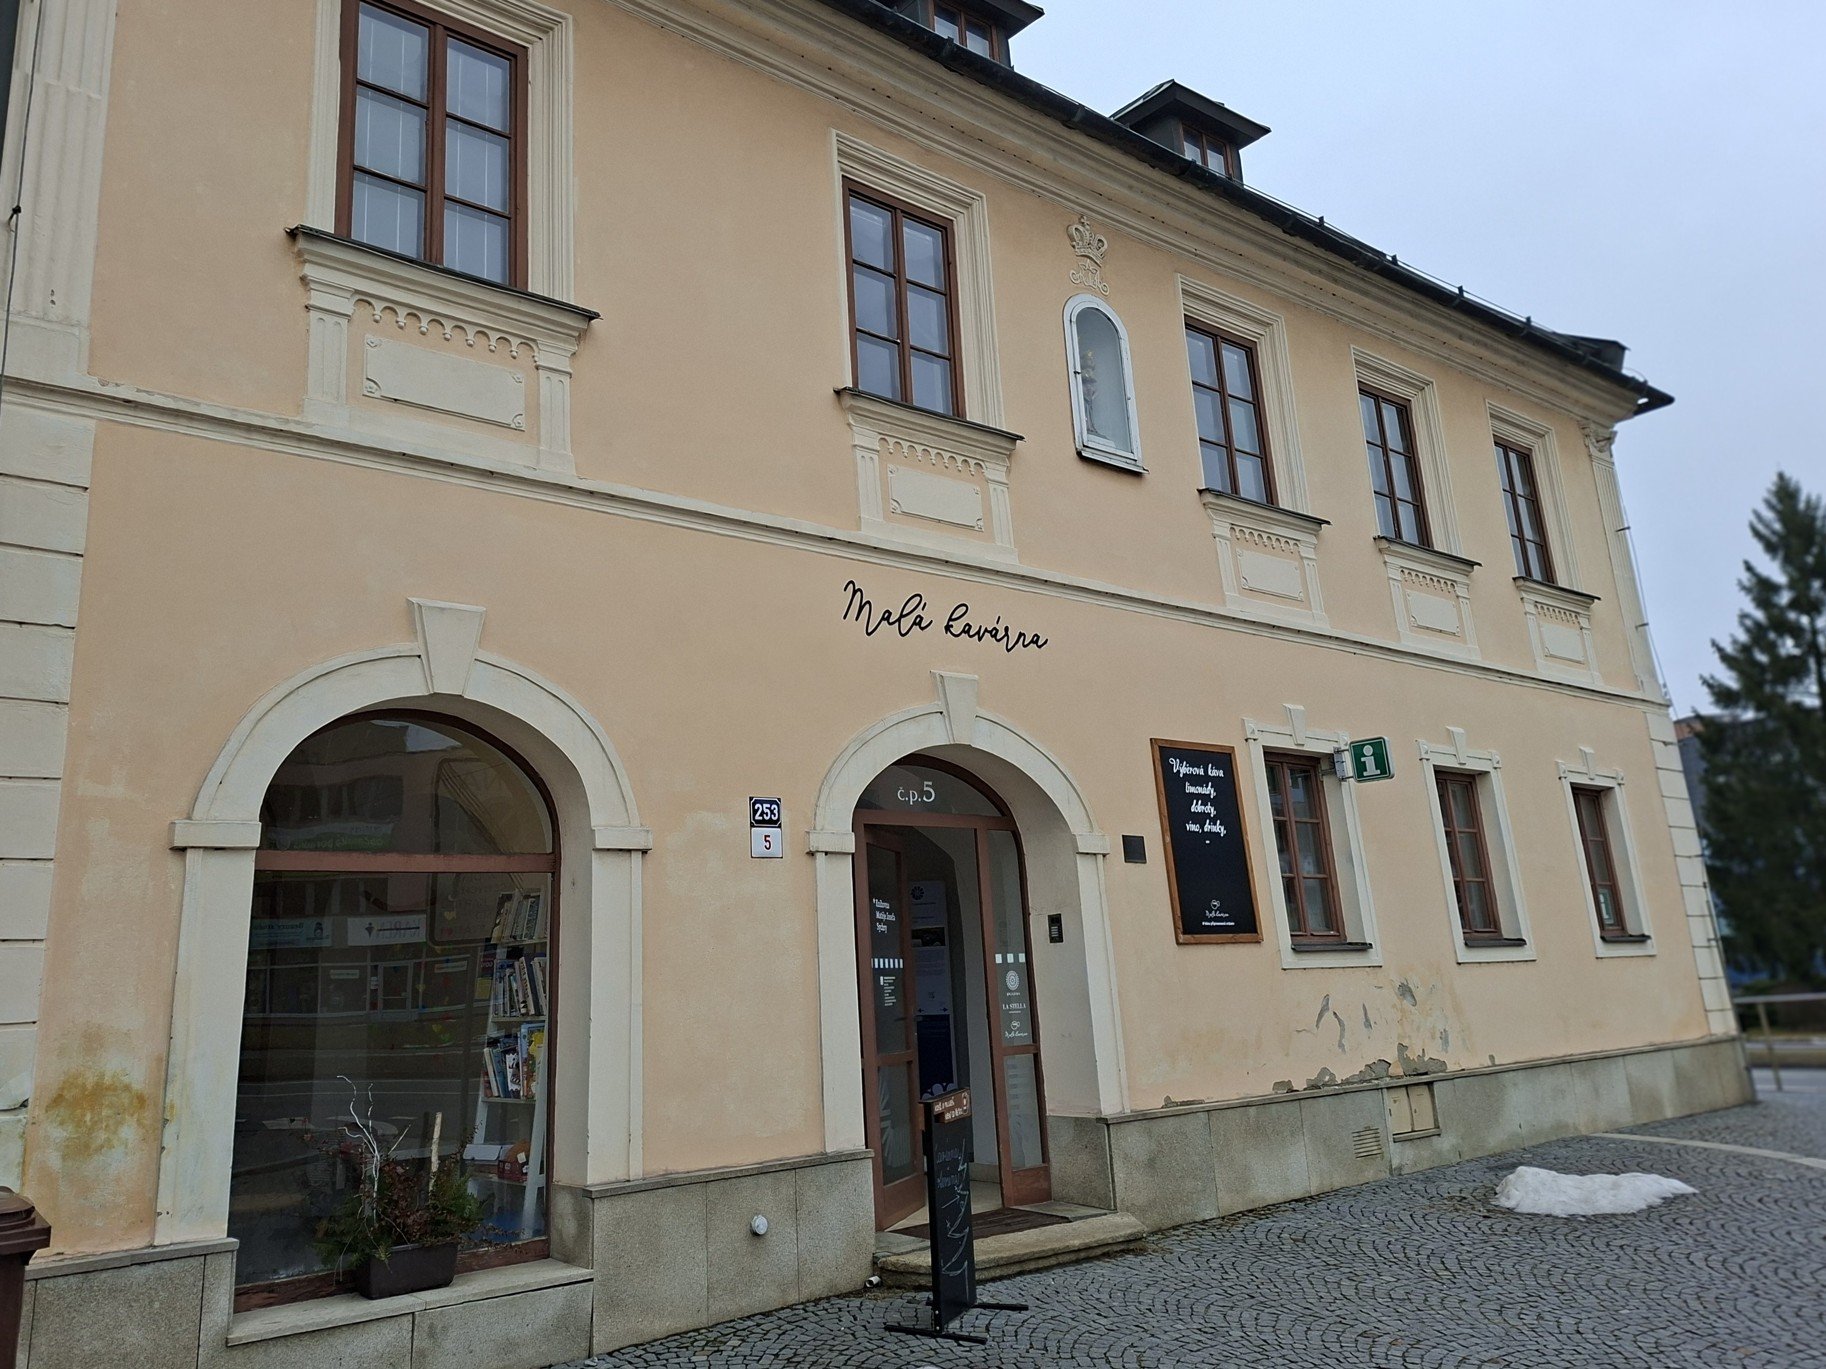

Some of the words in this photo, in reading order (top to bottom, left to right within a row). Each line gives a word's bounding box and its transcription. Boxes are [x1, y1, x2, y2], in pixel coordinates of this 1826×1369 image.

[843, 580, 933, 637] Malá
[944, 603, 1048, 653] kavárna
[1208, 763, 1225, 777] káva
[754, 803, 779, 820] 253
[763, 834, 772, 850] 5
